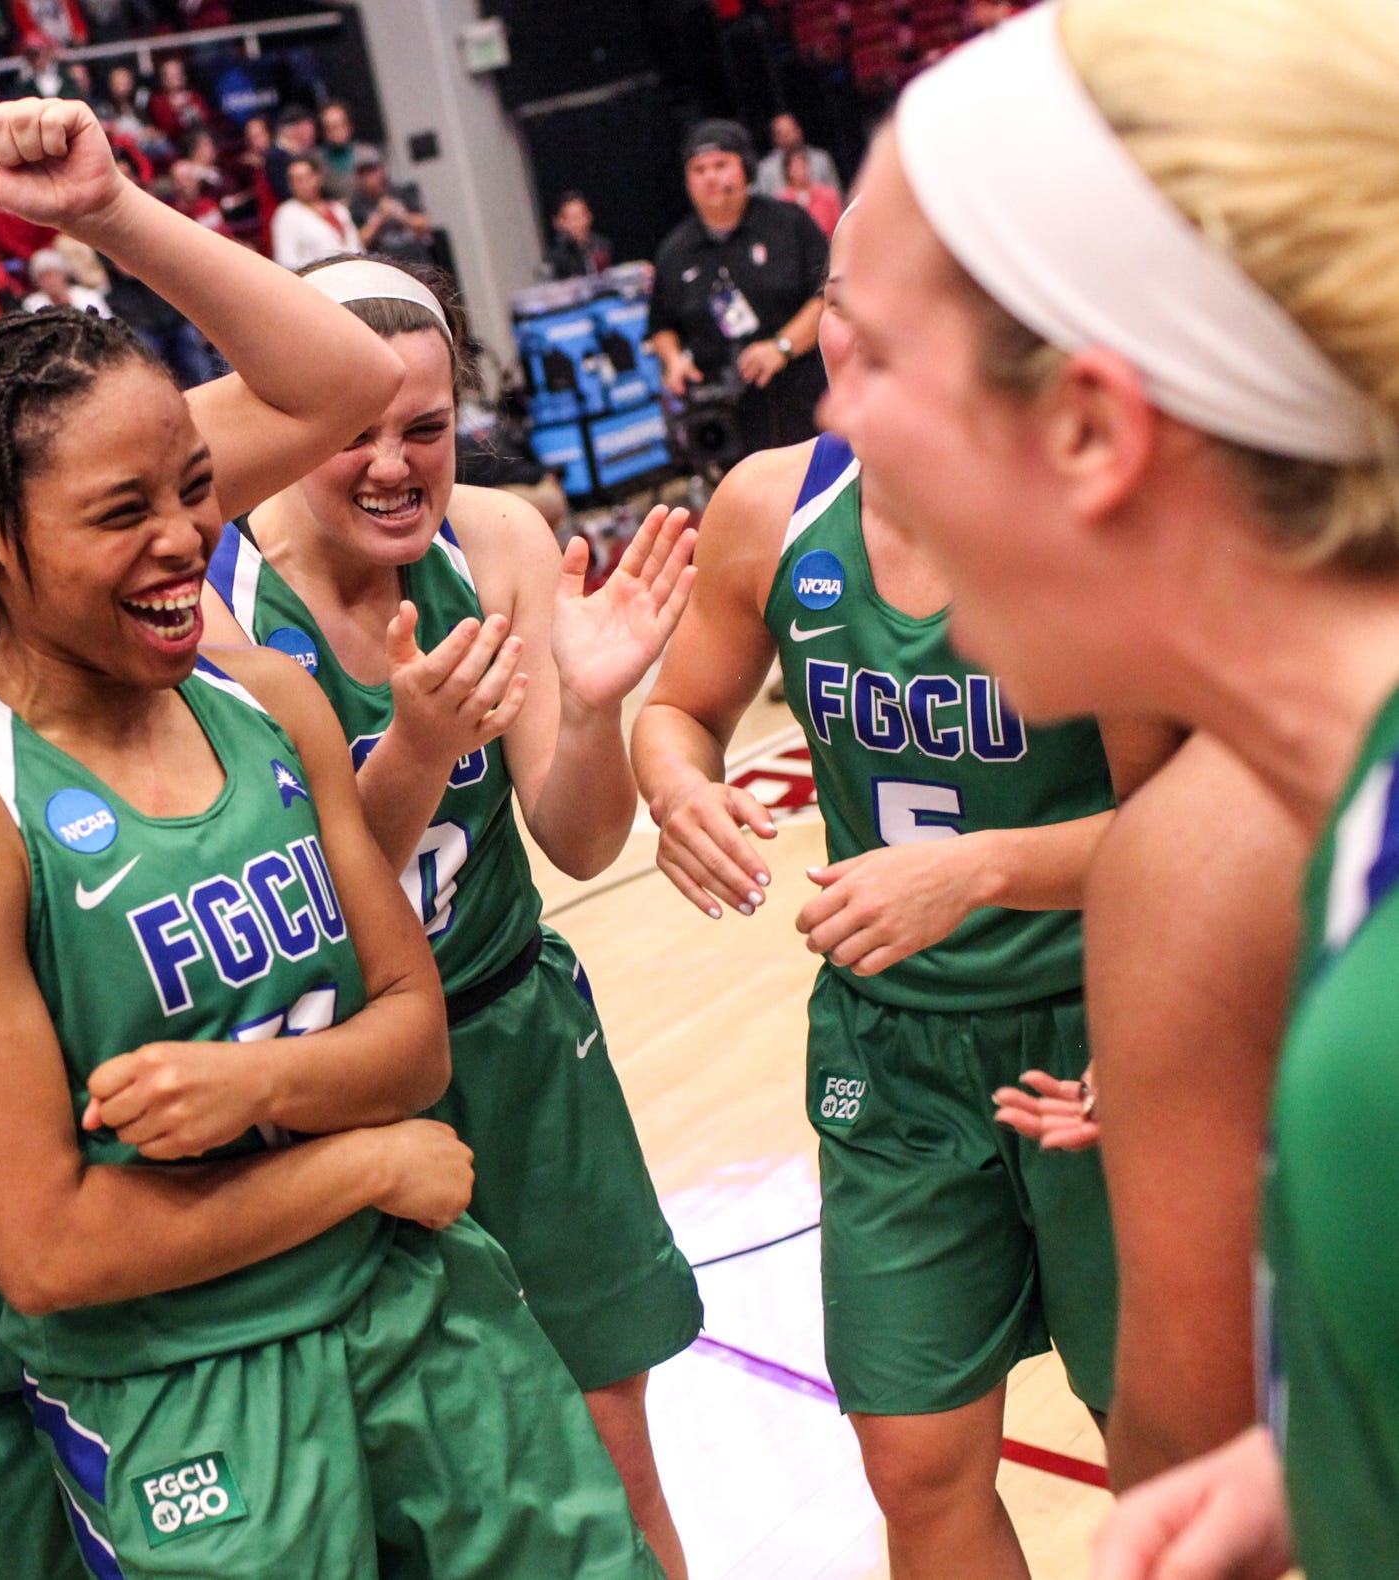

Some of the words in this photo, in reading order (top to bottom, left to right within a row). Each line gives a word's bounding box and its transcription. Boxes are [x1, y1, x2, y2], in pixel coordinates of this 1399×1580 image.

[798, 577, 841, 595] NCAA
[290, 652, 318, 667] AA
[805, 657, 1028, 762] FGCU
[59, 809, 116, 844] NCAA
[125, 834, 347, 1018] FGCU
[825, 1076, 867, 1098] FGCU
[834, 1098, 860, 1120] 20
[143, 1458, 219, 1506] FGCU
[179, 1485, 229, 1525] 20
